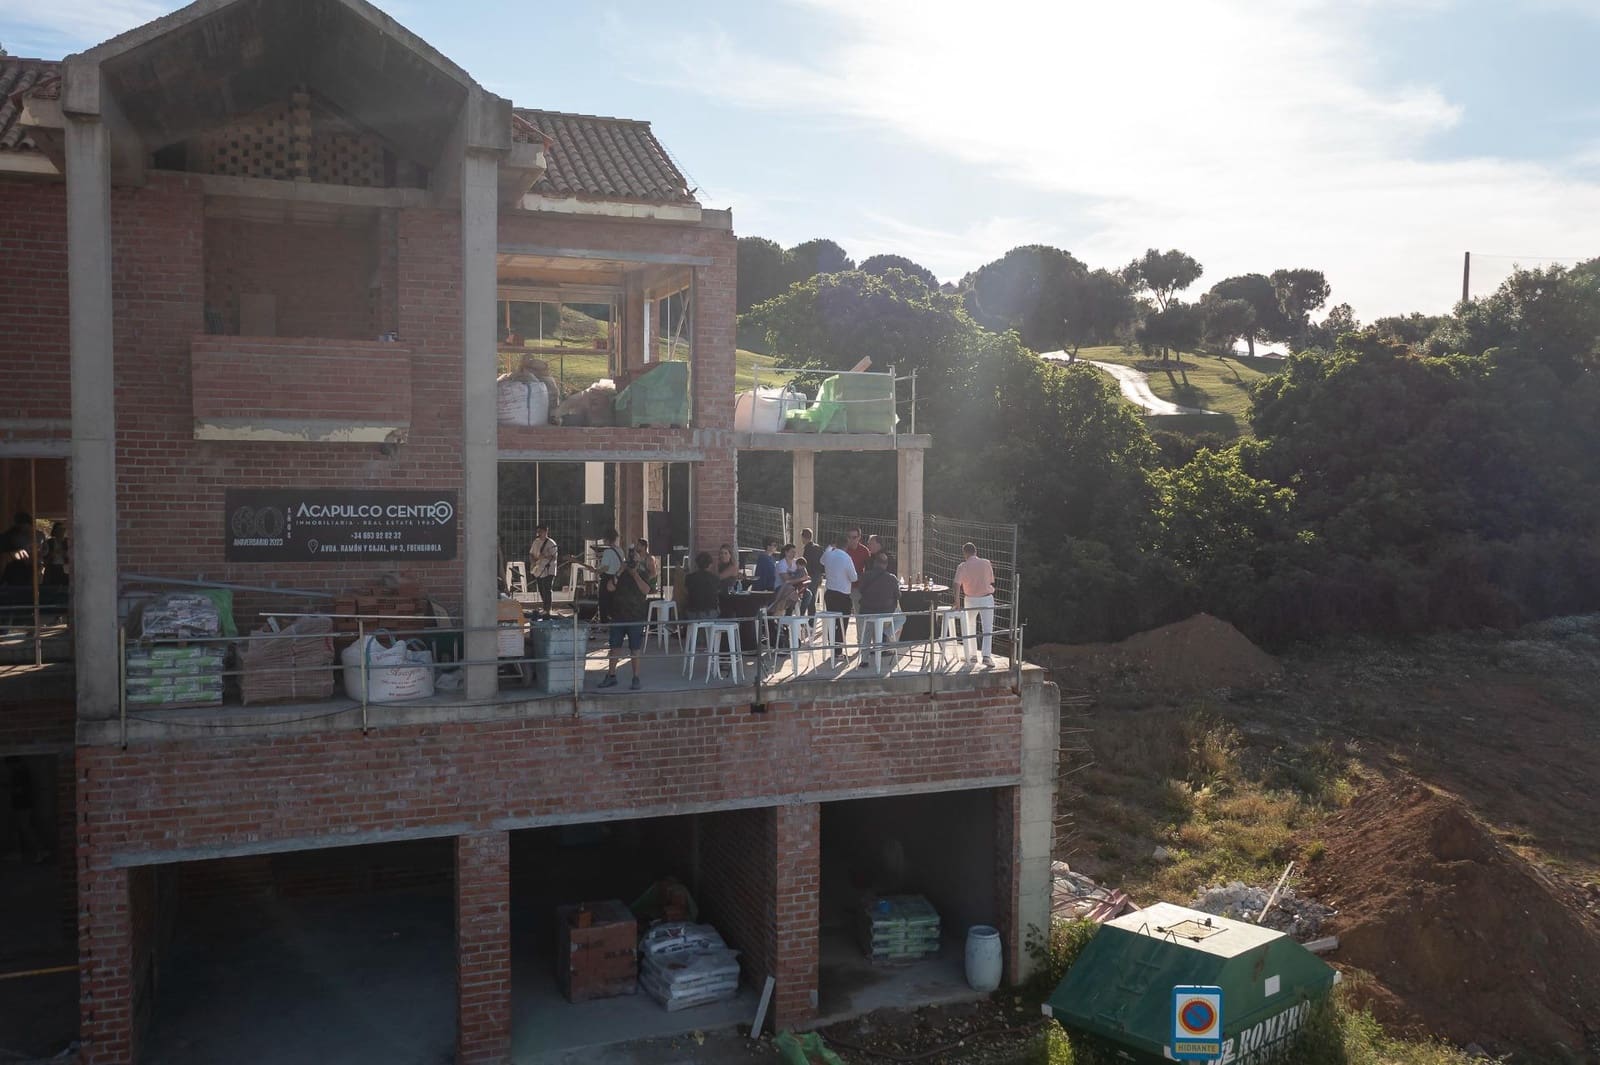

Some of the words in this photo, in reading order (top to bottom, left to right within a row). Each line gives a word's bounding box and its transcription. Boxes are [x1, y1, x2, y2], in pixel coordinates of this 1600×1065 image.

[232, 506, 284, 536] 60
[296, 502, 382, 518] ACAPULCO
[386, 503, 451, 520] CENTRO
[1238, 999, 1311, 1059] ROMERO
[1178, 1044, 1217, 1053] HIDRANTE
